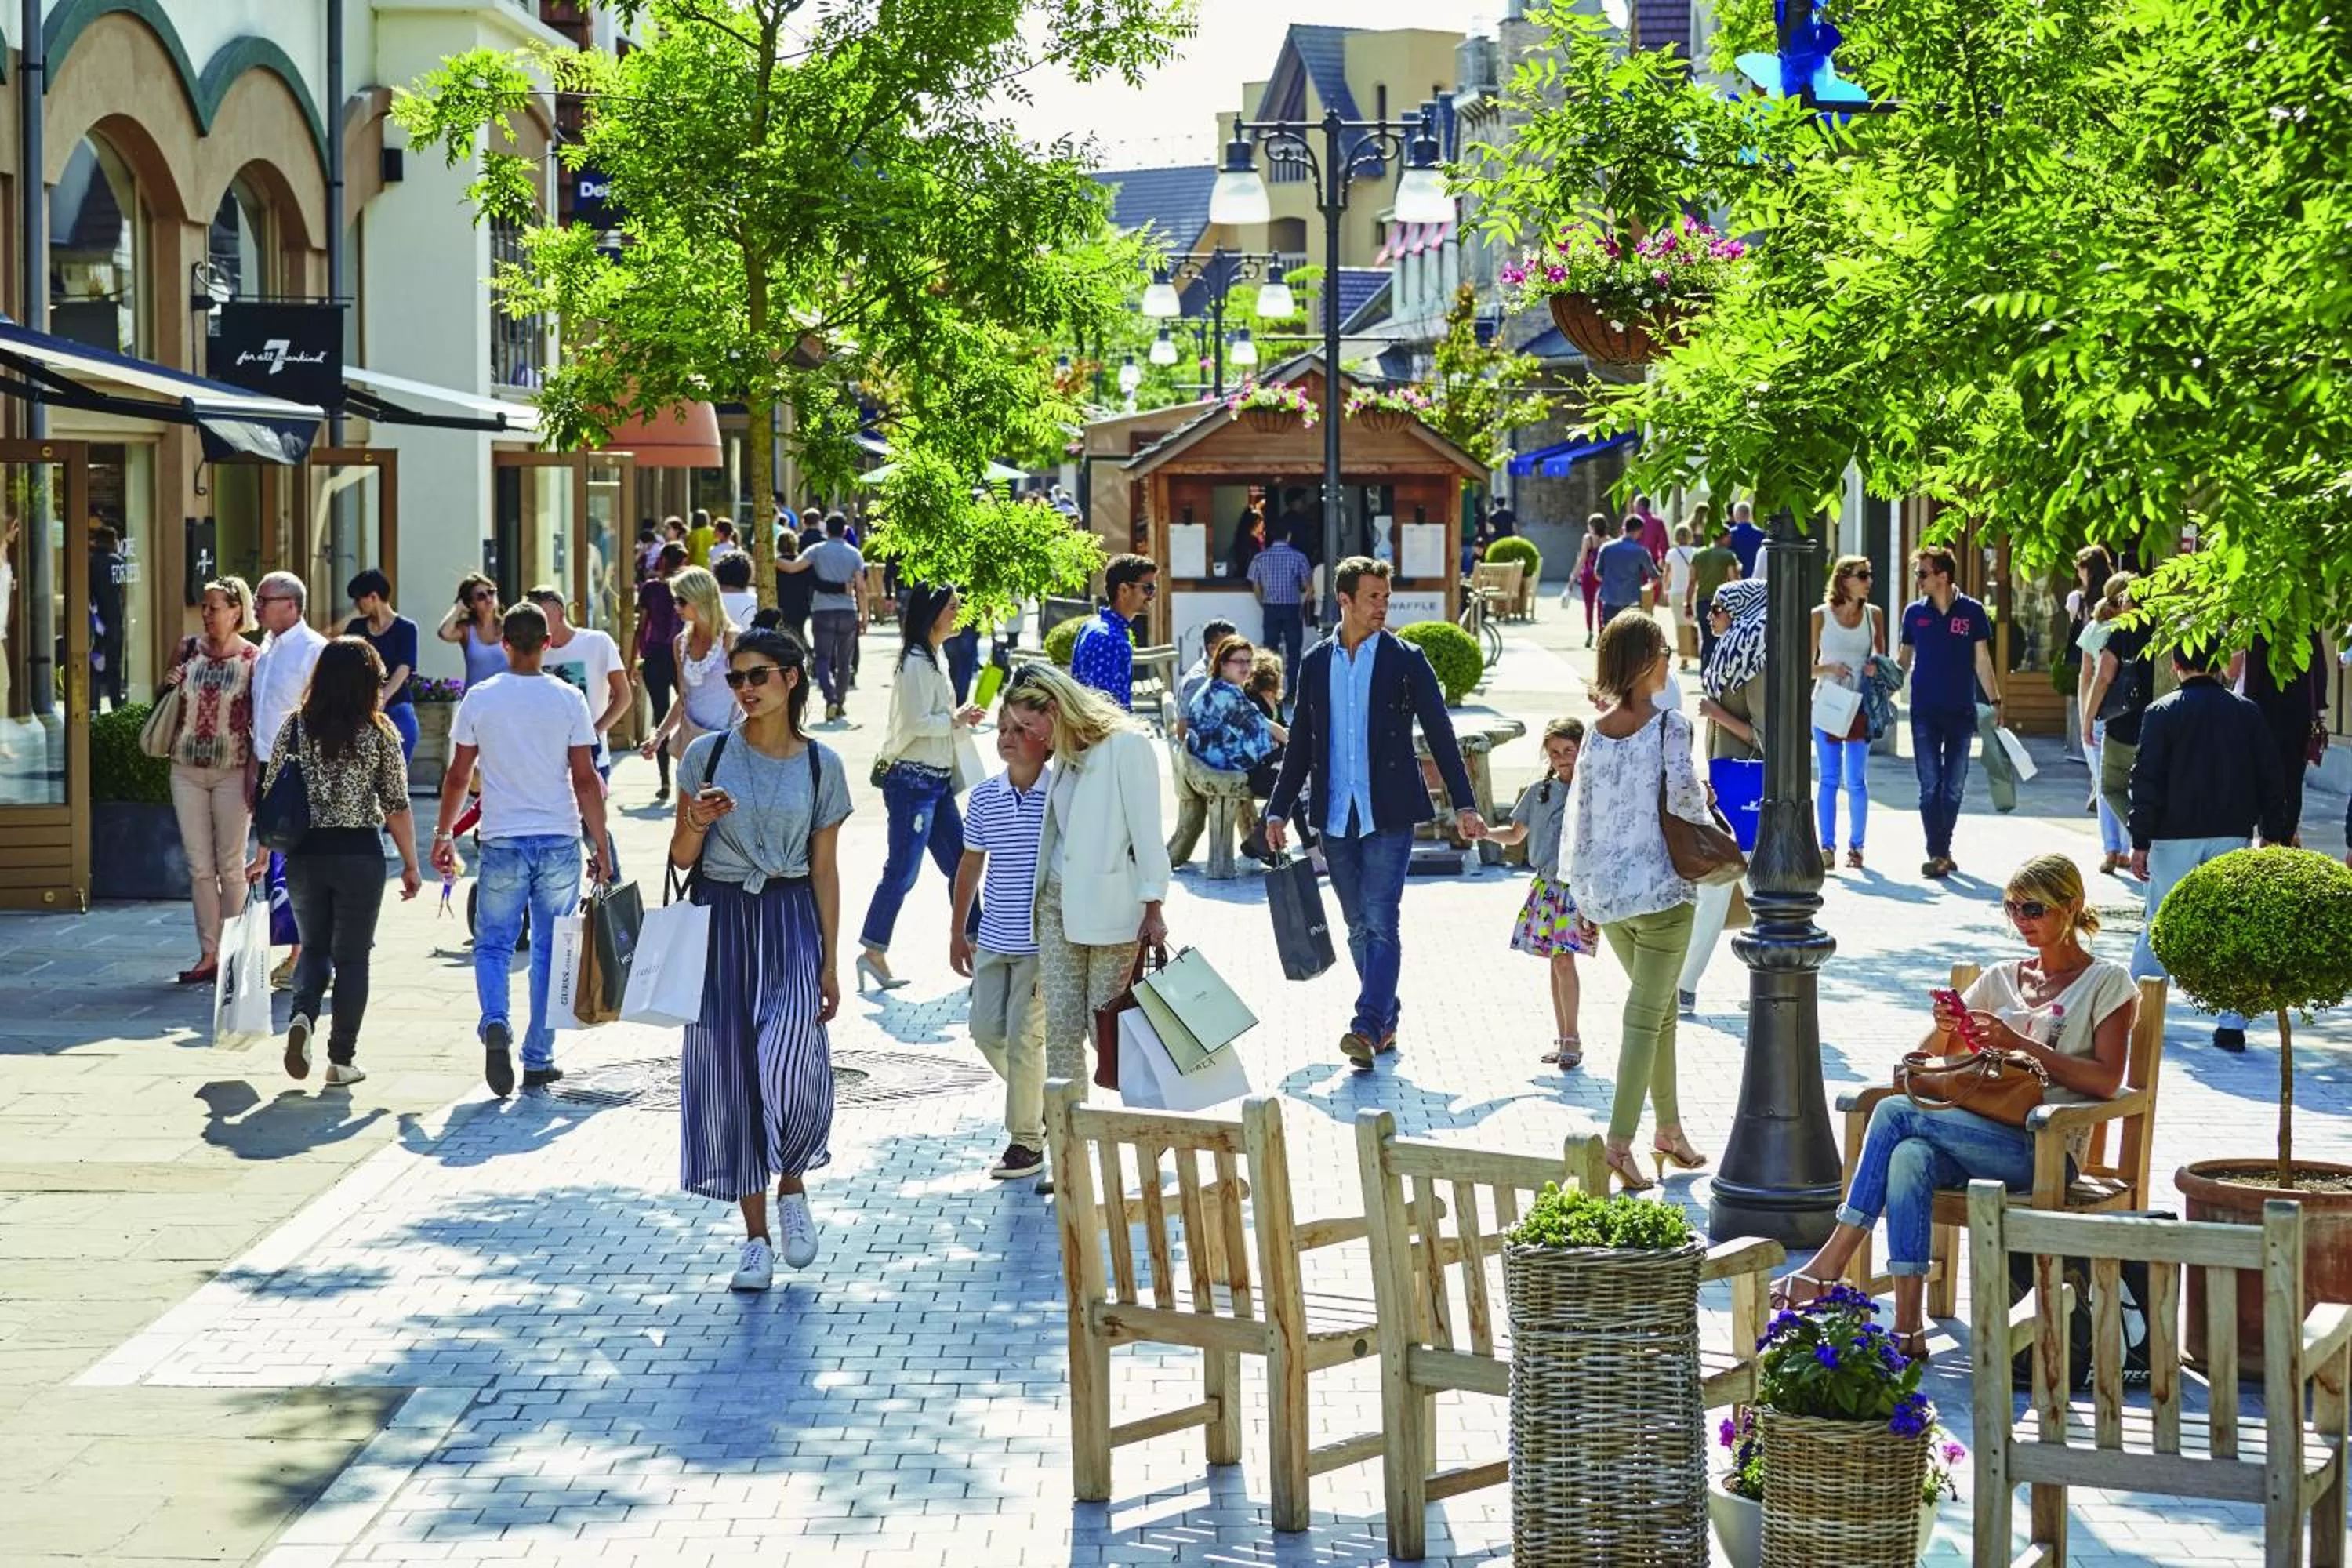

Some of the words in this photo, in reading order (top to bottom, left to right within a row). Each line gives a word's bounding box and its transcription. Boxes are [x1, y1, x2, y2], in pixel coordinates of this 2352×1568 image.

[256, 351, 274, 361] all
[263, 339, 291, 375] 7
[1388, 601, 1437, 611] WAFFLE
